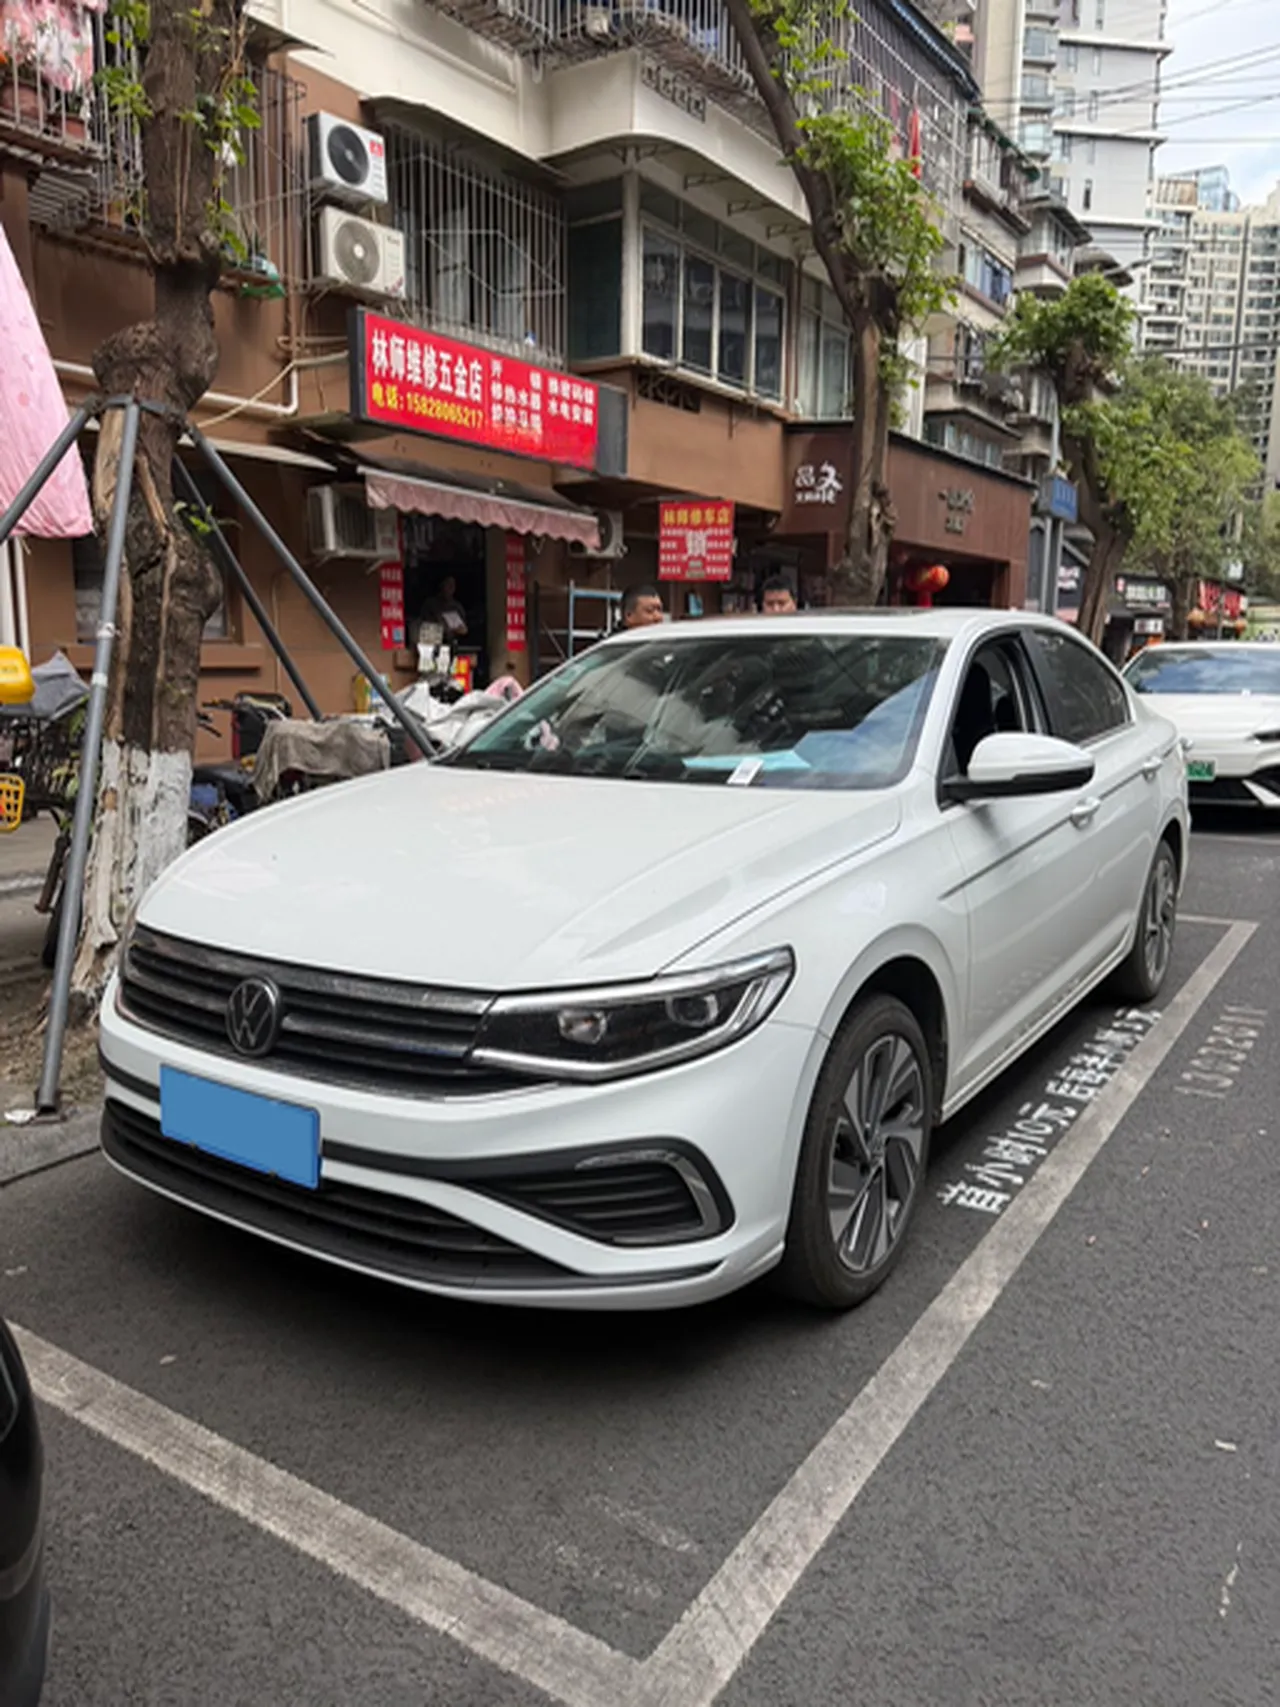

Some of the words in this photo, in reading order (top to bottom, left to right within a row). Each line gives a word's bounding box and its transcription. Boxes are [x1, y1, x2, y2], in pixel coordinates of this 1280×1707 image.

[371, 329, 483, 402] 林师维修五金店
